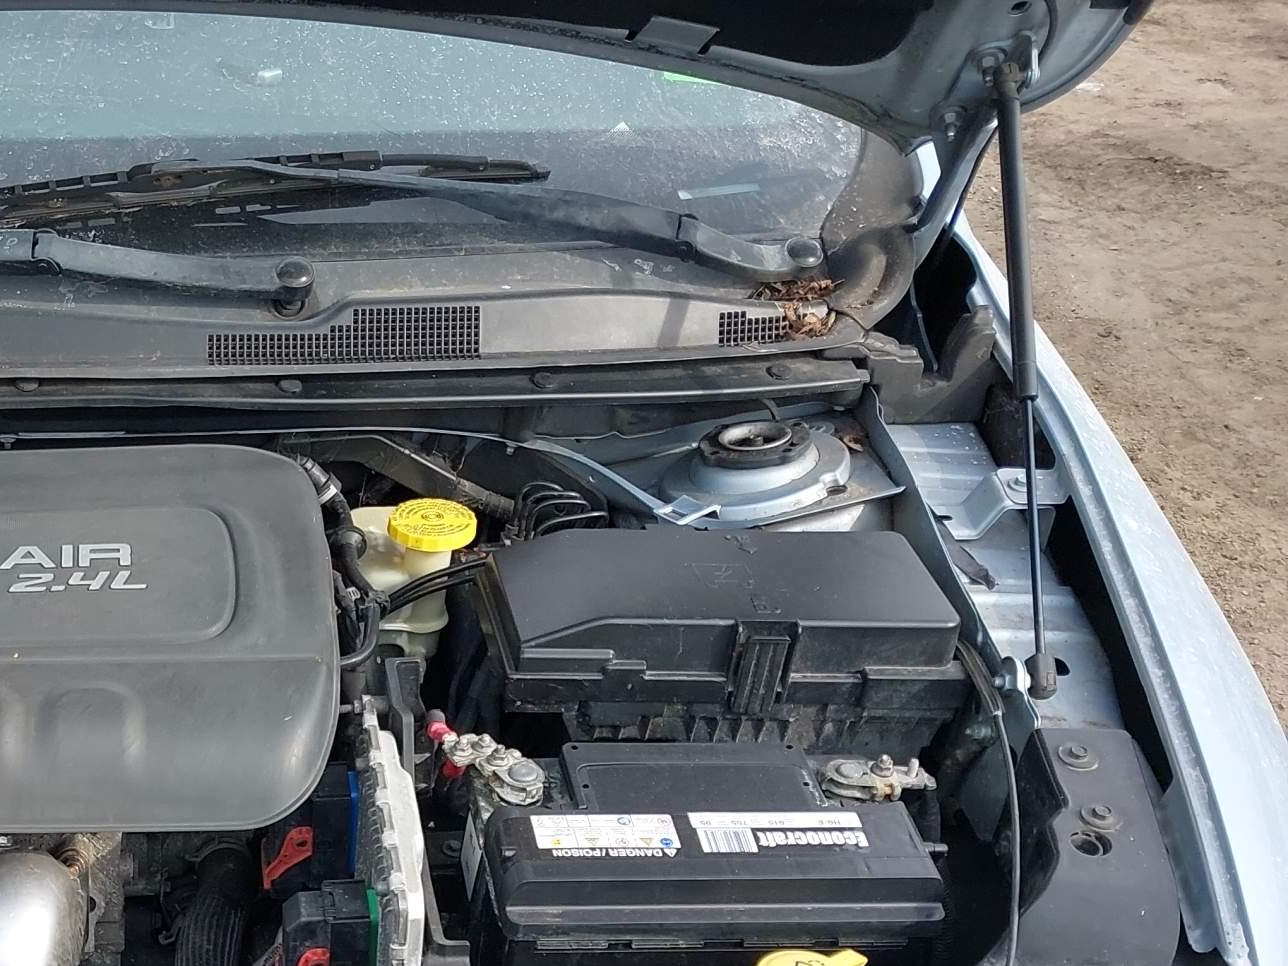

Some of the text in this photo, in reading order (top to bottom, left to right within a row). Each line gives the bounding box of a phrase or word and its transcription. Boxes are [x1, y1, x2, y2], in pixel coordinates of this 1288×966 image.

[8, 570, 148, 592] 2.4L
[756, 830, 870, 848] Econocraft
[608, 848, 663, 857] DANGER
